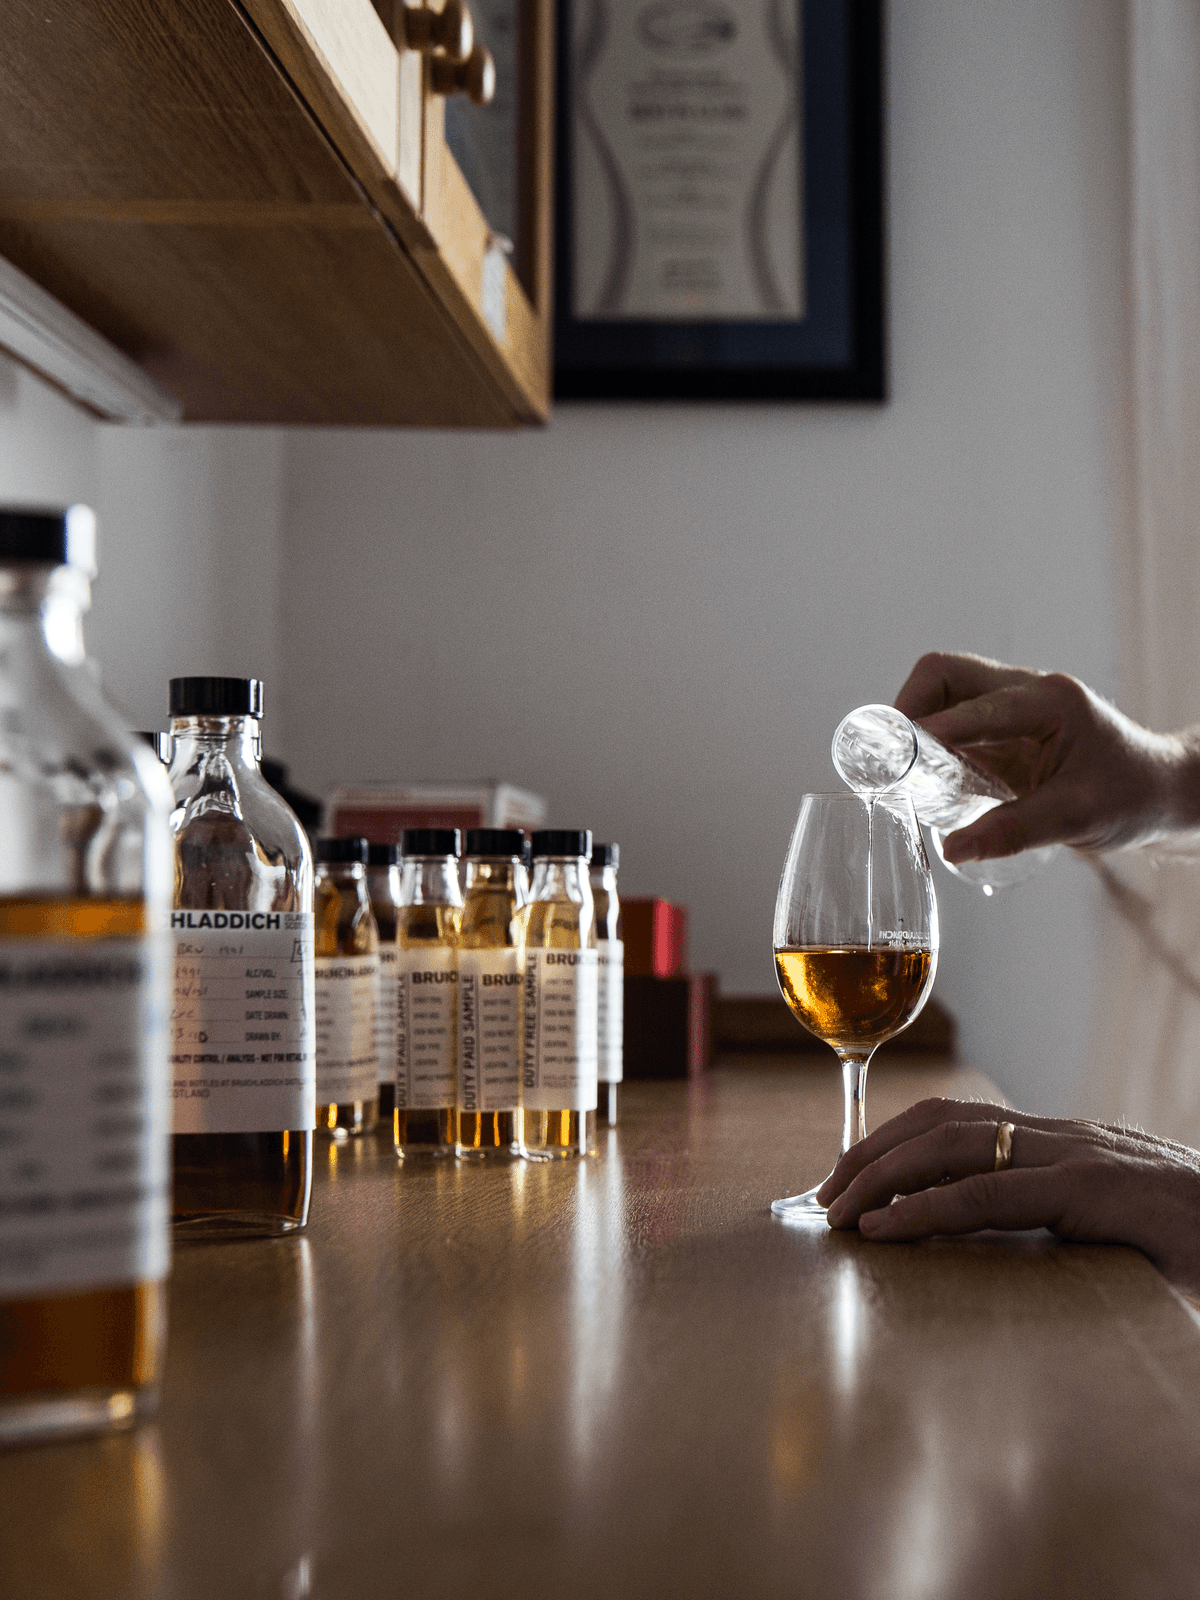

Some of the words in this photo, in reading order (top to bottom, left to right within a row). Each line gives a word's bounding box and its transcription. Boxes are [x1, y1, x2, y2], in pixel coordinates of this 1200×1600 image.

[525, 955, 538, 1008] SAMPLE
[461, 973, 475, 1032] SAMPLE
[524, 1013, 537, 1048] FREE
[462, 1035, 476, 1070] PAID
[524, 1054, 536, 1088] DUTY
[463, 1071, 476, 1110] DUTY
